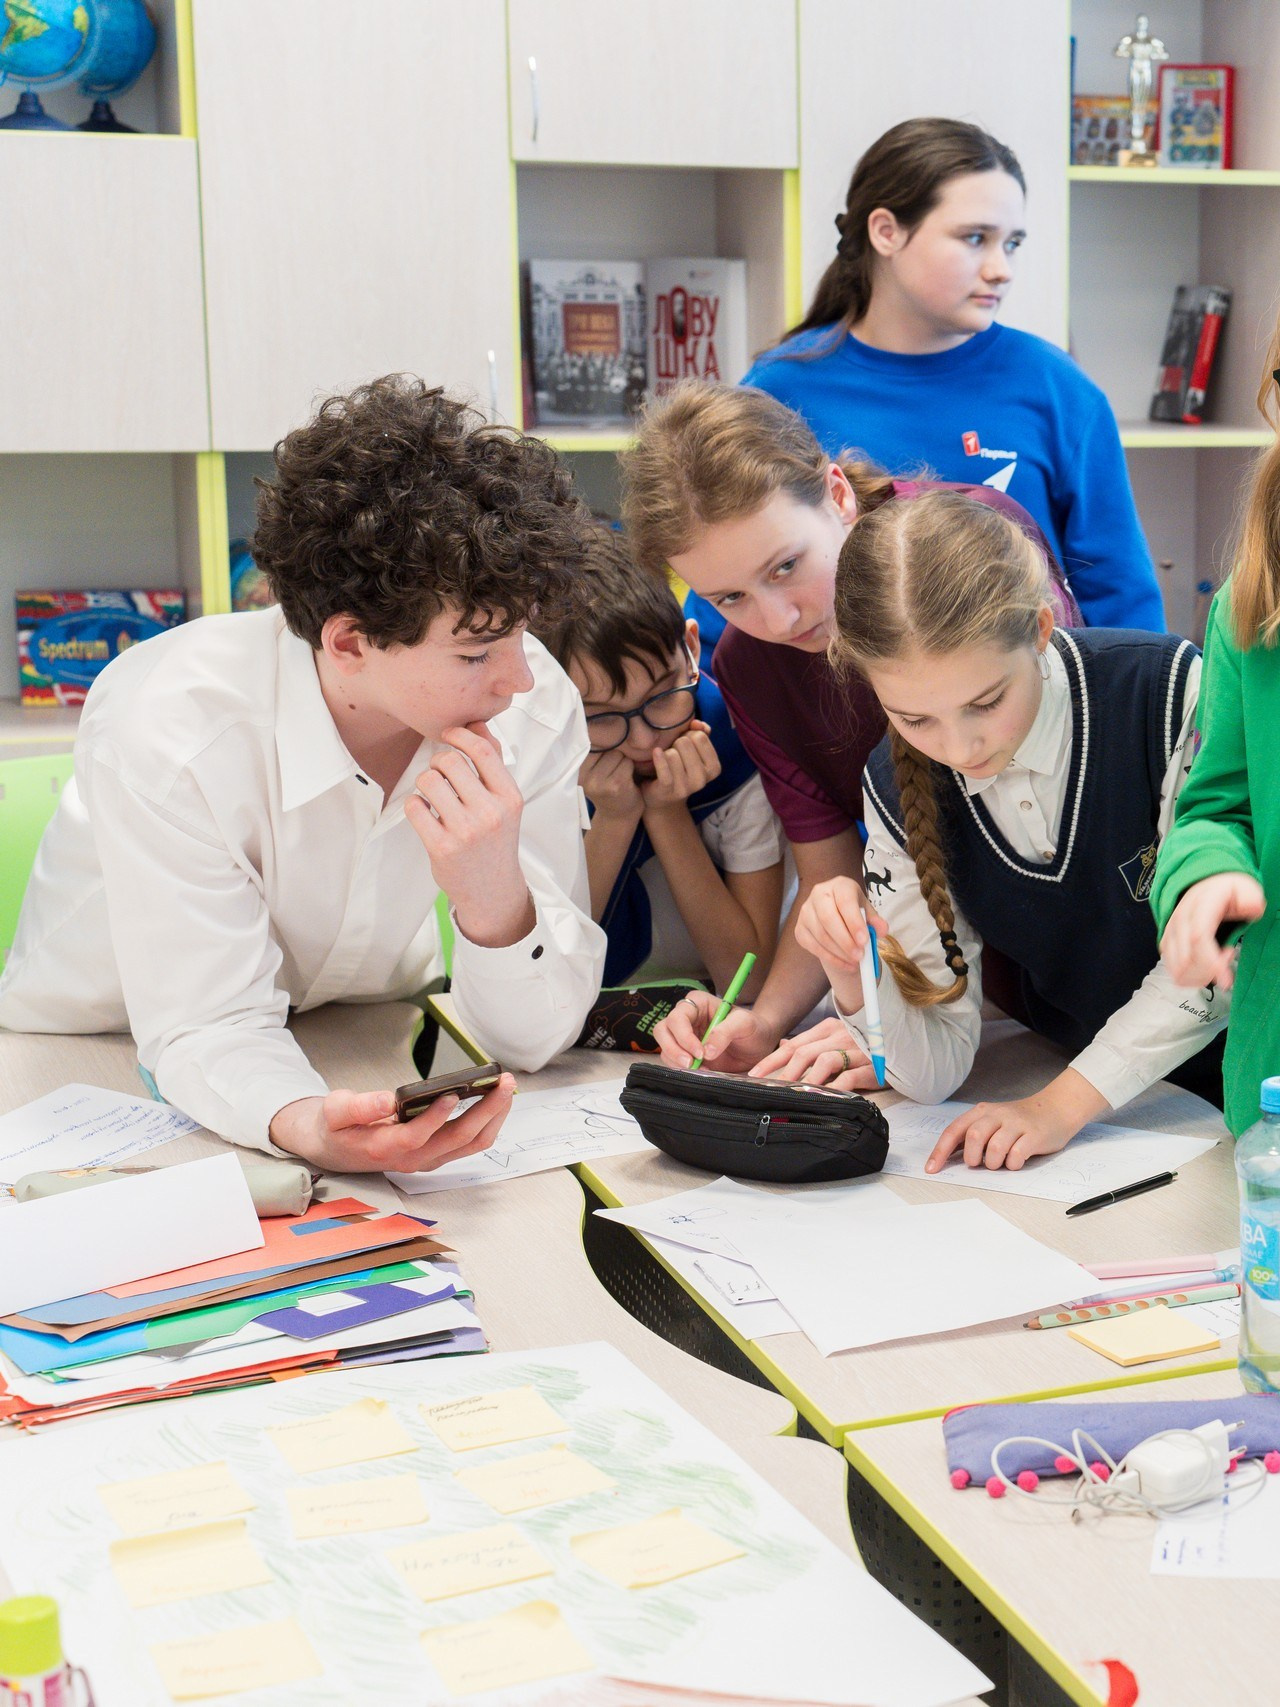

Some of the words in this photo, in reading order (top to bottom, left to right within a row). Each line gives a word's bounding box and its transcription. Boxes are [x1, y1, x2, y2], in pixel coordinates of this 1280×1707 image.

[653, 285, 720, 344] ЛОВУ
[654, 339, 721, 381] ШКА
[636, 1000, 667, 1032] GAME
[583, 1026, 608, 1048] AME
